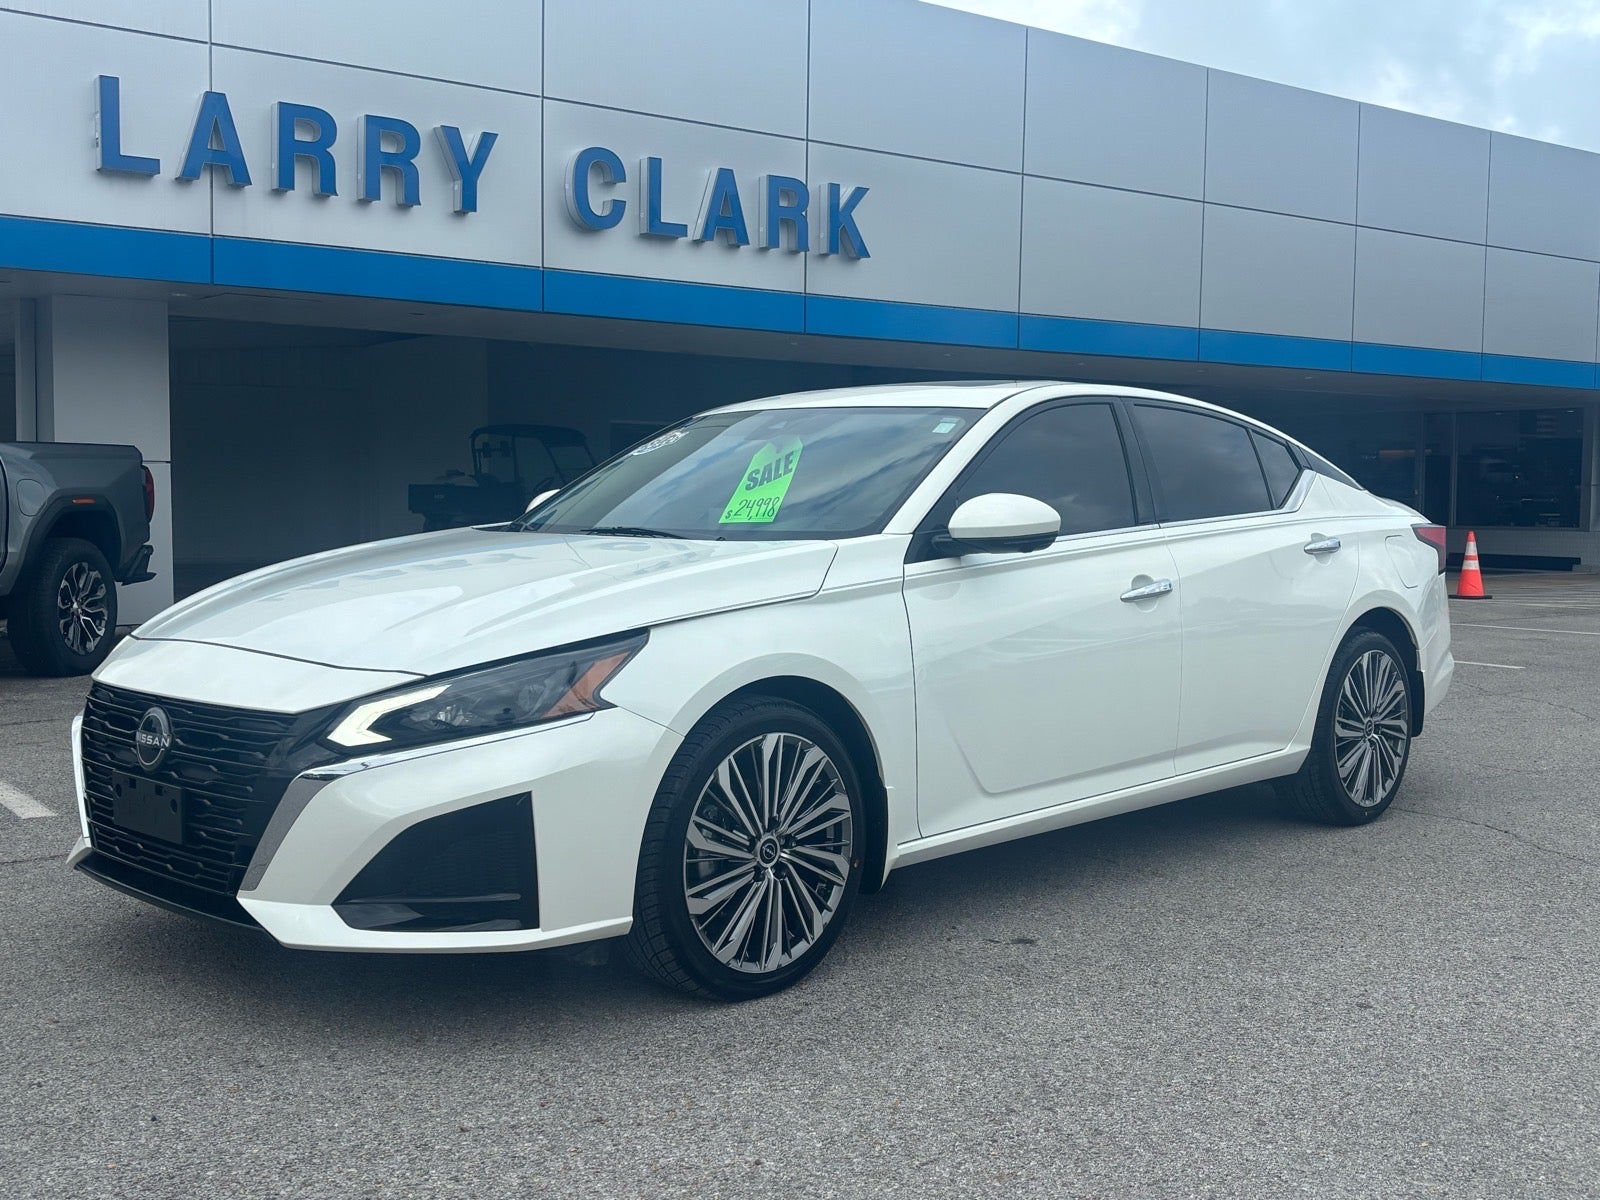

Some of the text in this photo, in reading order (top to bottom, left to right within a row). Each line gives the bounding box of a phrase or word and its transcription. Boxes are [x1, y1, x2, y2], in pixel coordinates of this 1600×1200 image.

[96, 75, 871, 259] LARRY CLARK
[745, 451, 794, 491] SALE
